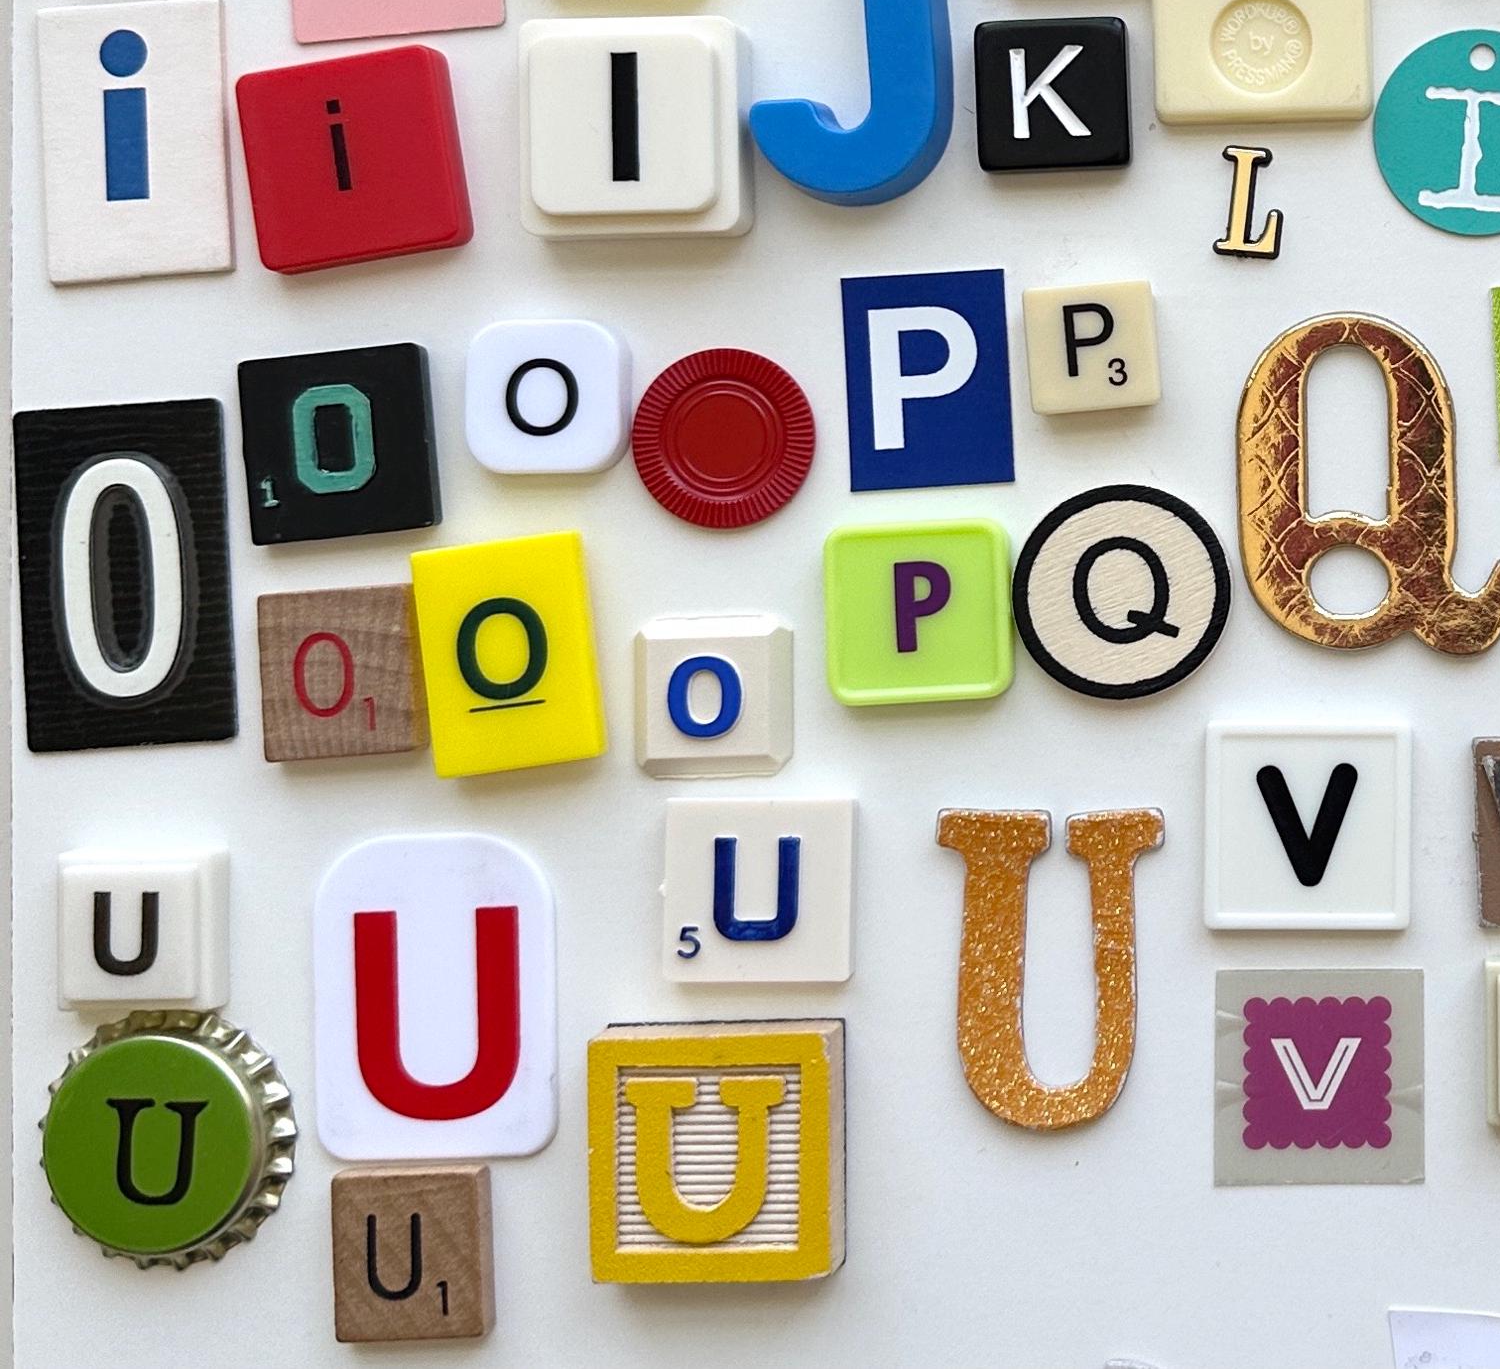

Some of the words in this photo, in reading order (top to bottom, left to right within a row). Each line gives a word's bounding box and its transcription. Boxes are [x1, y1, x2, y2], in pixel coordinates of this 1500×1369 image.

[1009, 44, 1092, 139] K
[1248, 31, 1275, 55] by
[100, 29, 150, 202] i
[325, 99, 353, 192] i
[610, 52, 640, 182] I
[1213, 144, 1284, 260] L
[867, 305, 979, 450] P
[1062, 302, 1115, 378] P
[292, 383, 376, 496] O
[505, 357, 580, 437] O
[61, 456, 186, 699] O
[893, 560, 952, 654] P
[1072, 535, 1180, 645] Q
[292, 631, 355, 718] O
[456, 596, 549, 701] O
[666, 655, 744, 739] O
[1255, 761, 1359, 888] V
[92, 890, 159, 977] U
[713, 835, 802, 943] U
[353, 904, 521, 1121] U
[935, 806, 1166, 1132] U
[1270, 1036, 1363, 1111] V
[106, 1096, 211, 1206] U
[624, 1075, 785, 1246] U
[365, 1211, 424, 1301] U
